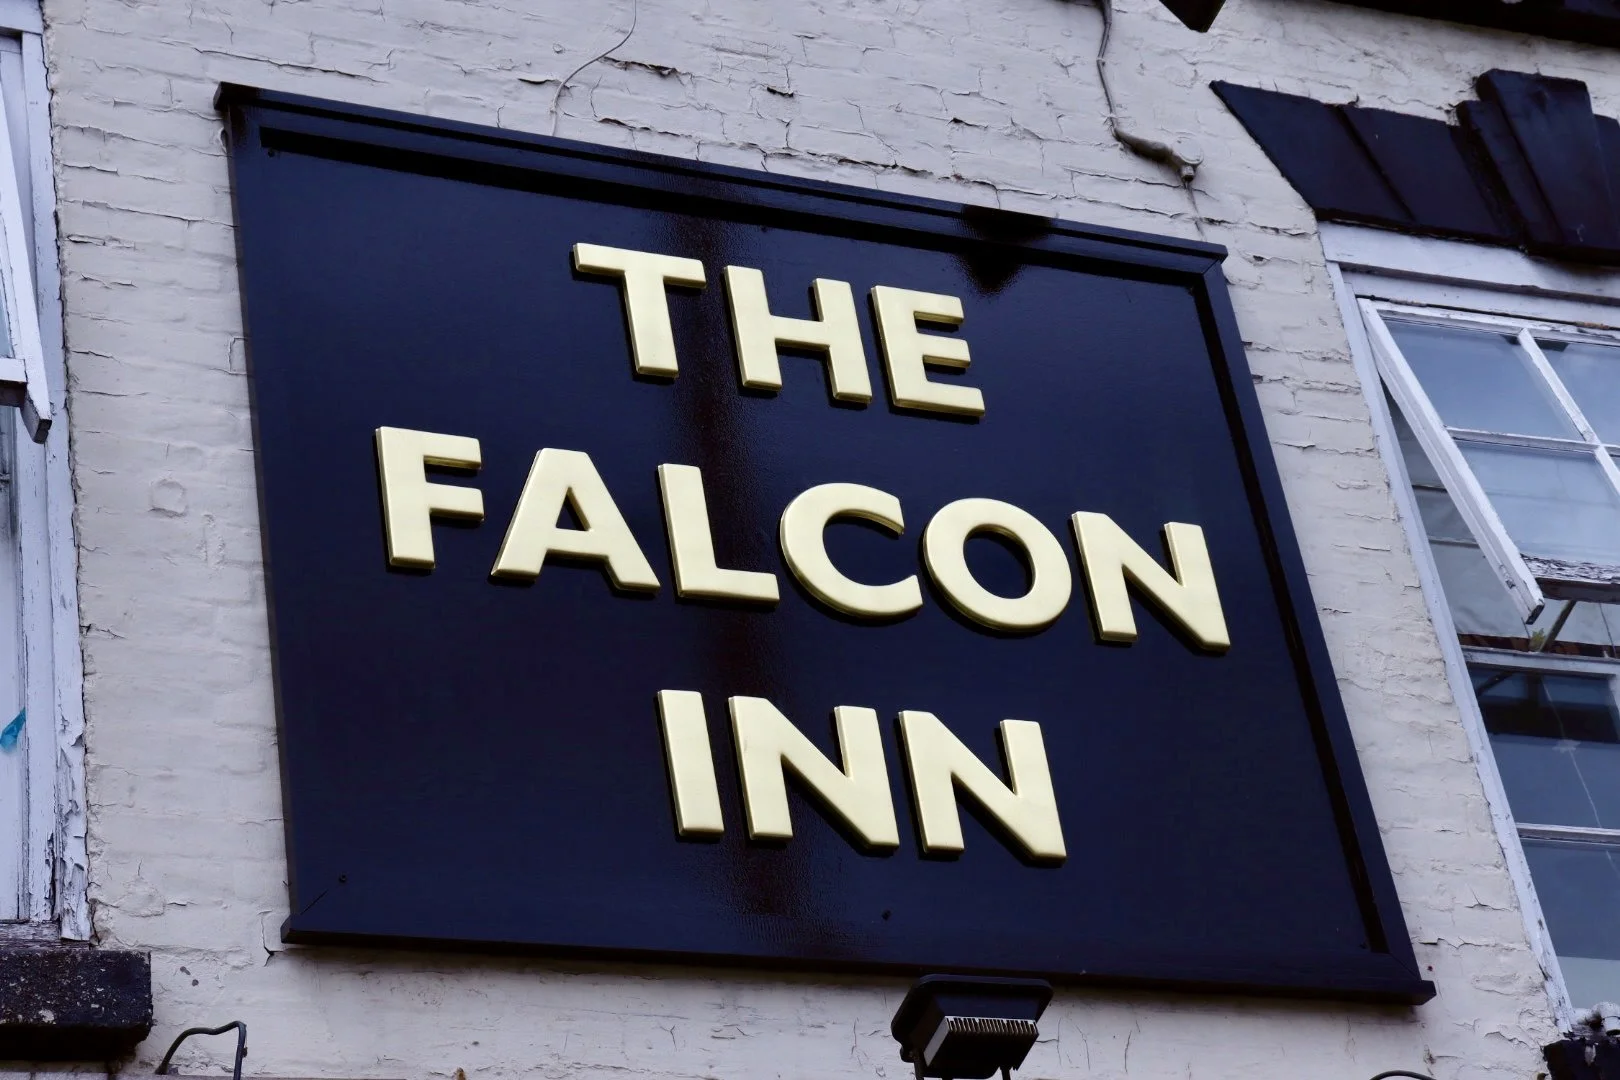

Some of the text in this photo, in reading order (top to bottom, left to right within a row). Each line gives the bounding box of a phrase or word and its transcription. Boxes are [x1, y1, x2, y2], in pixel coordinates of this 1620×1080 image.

[572, 242, 986, 418] THE
[374, 424, 1232, 649] FALCON
[658, 688, 1067, 860] INN
